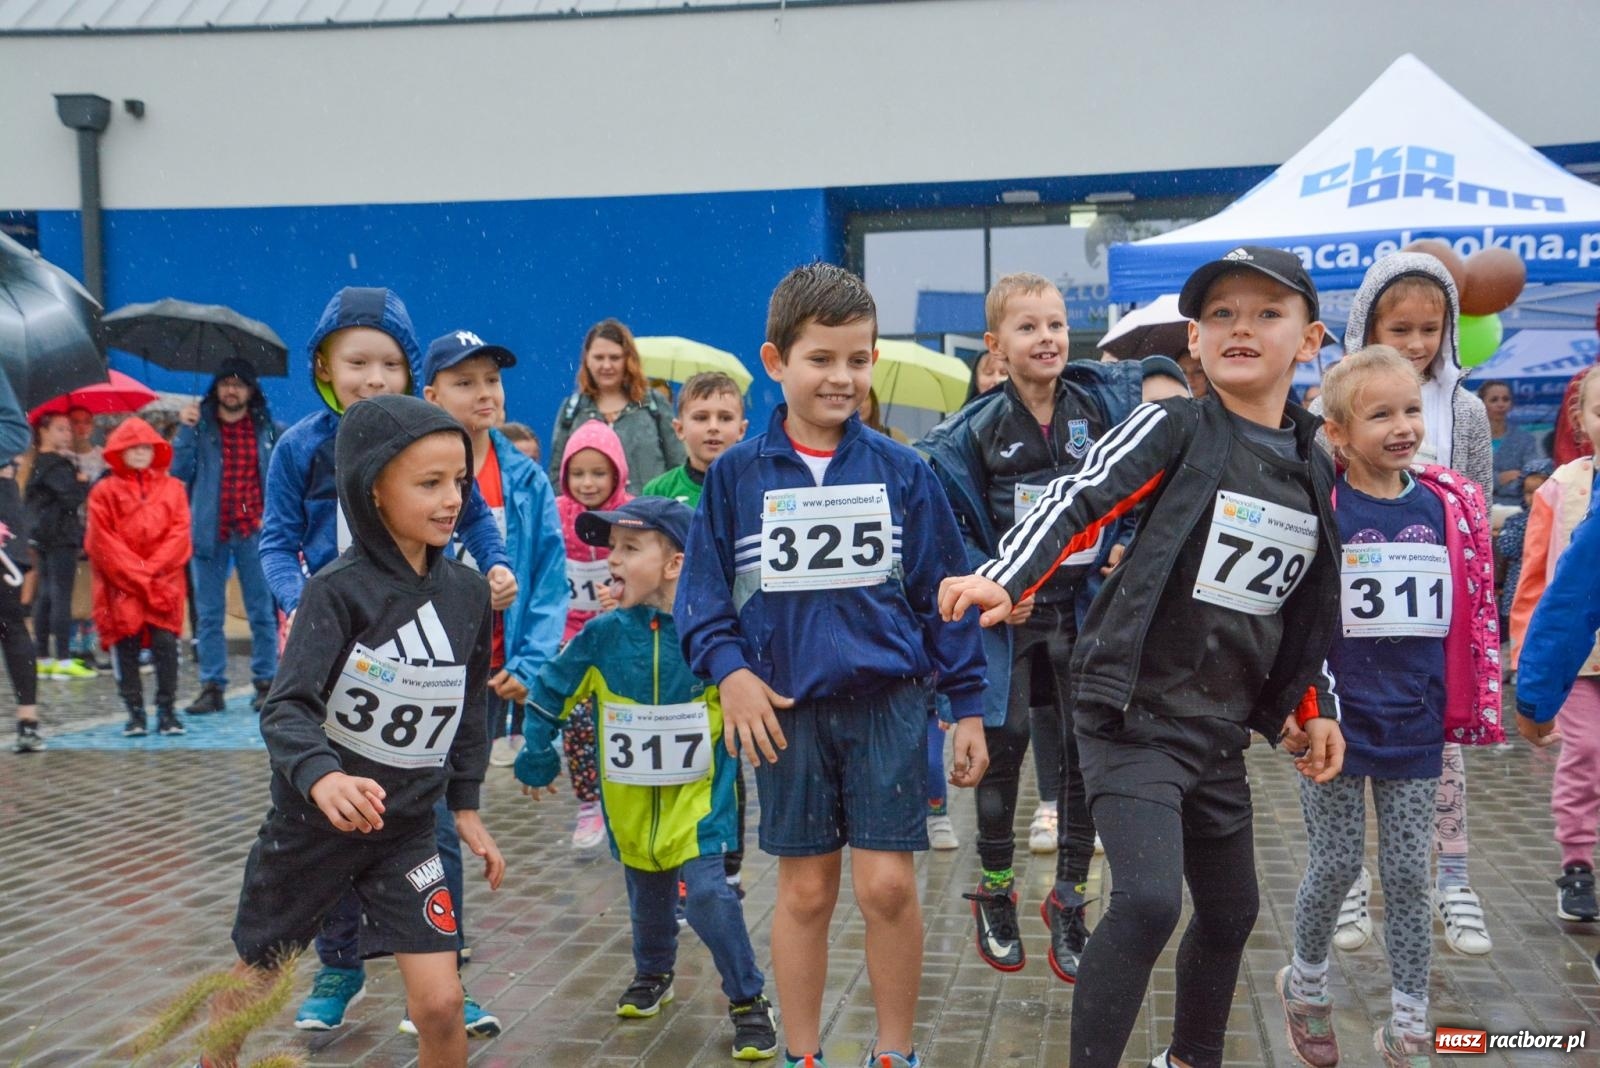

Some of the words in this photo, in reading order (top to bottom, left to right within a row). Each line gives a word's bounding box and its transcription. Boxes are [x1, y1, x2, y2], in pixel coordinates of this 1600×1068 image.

[1347, 173, 1566, 213] okna
[803, 495, 883, 508] www.personalbest.pl
[768, 521, 884, 571] 325
[1214, 532, 1305, 598] 729
[1350, 577, 1443, 619] 311
[335, 687, 457, 749] 387
[610, 733, 703, 769] 317
